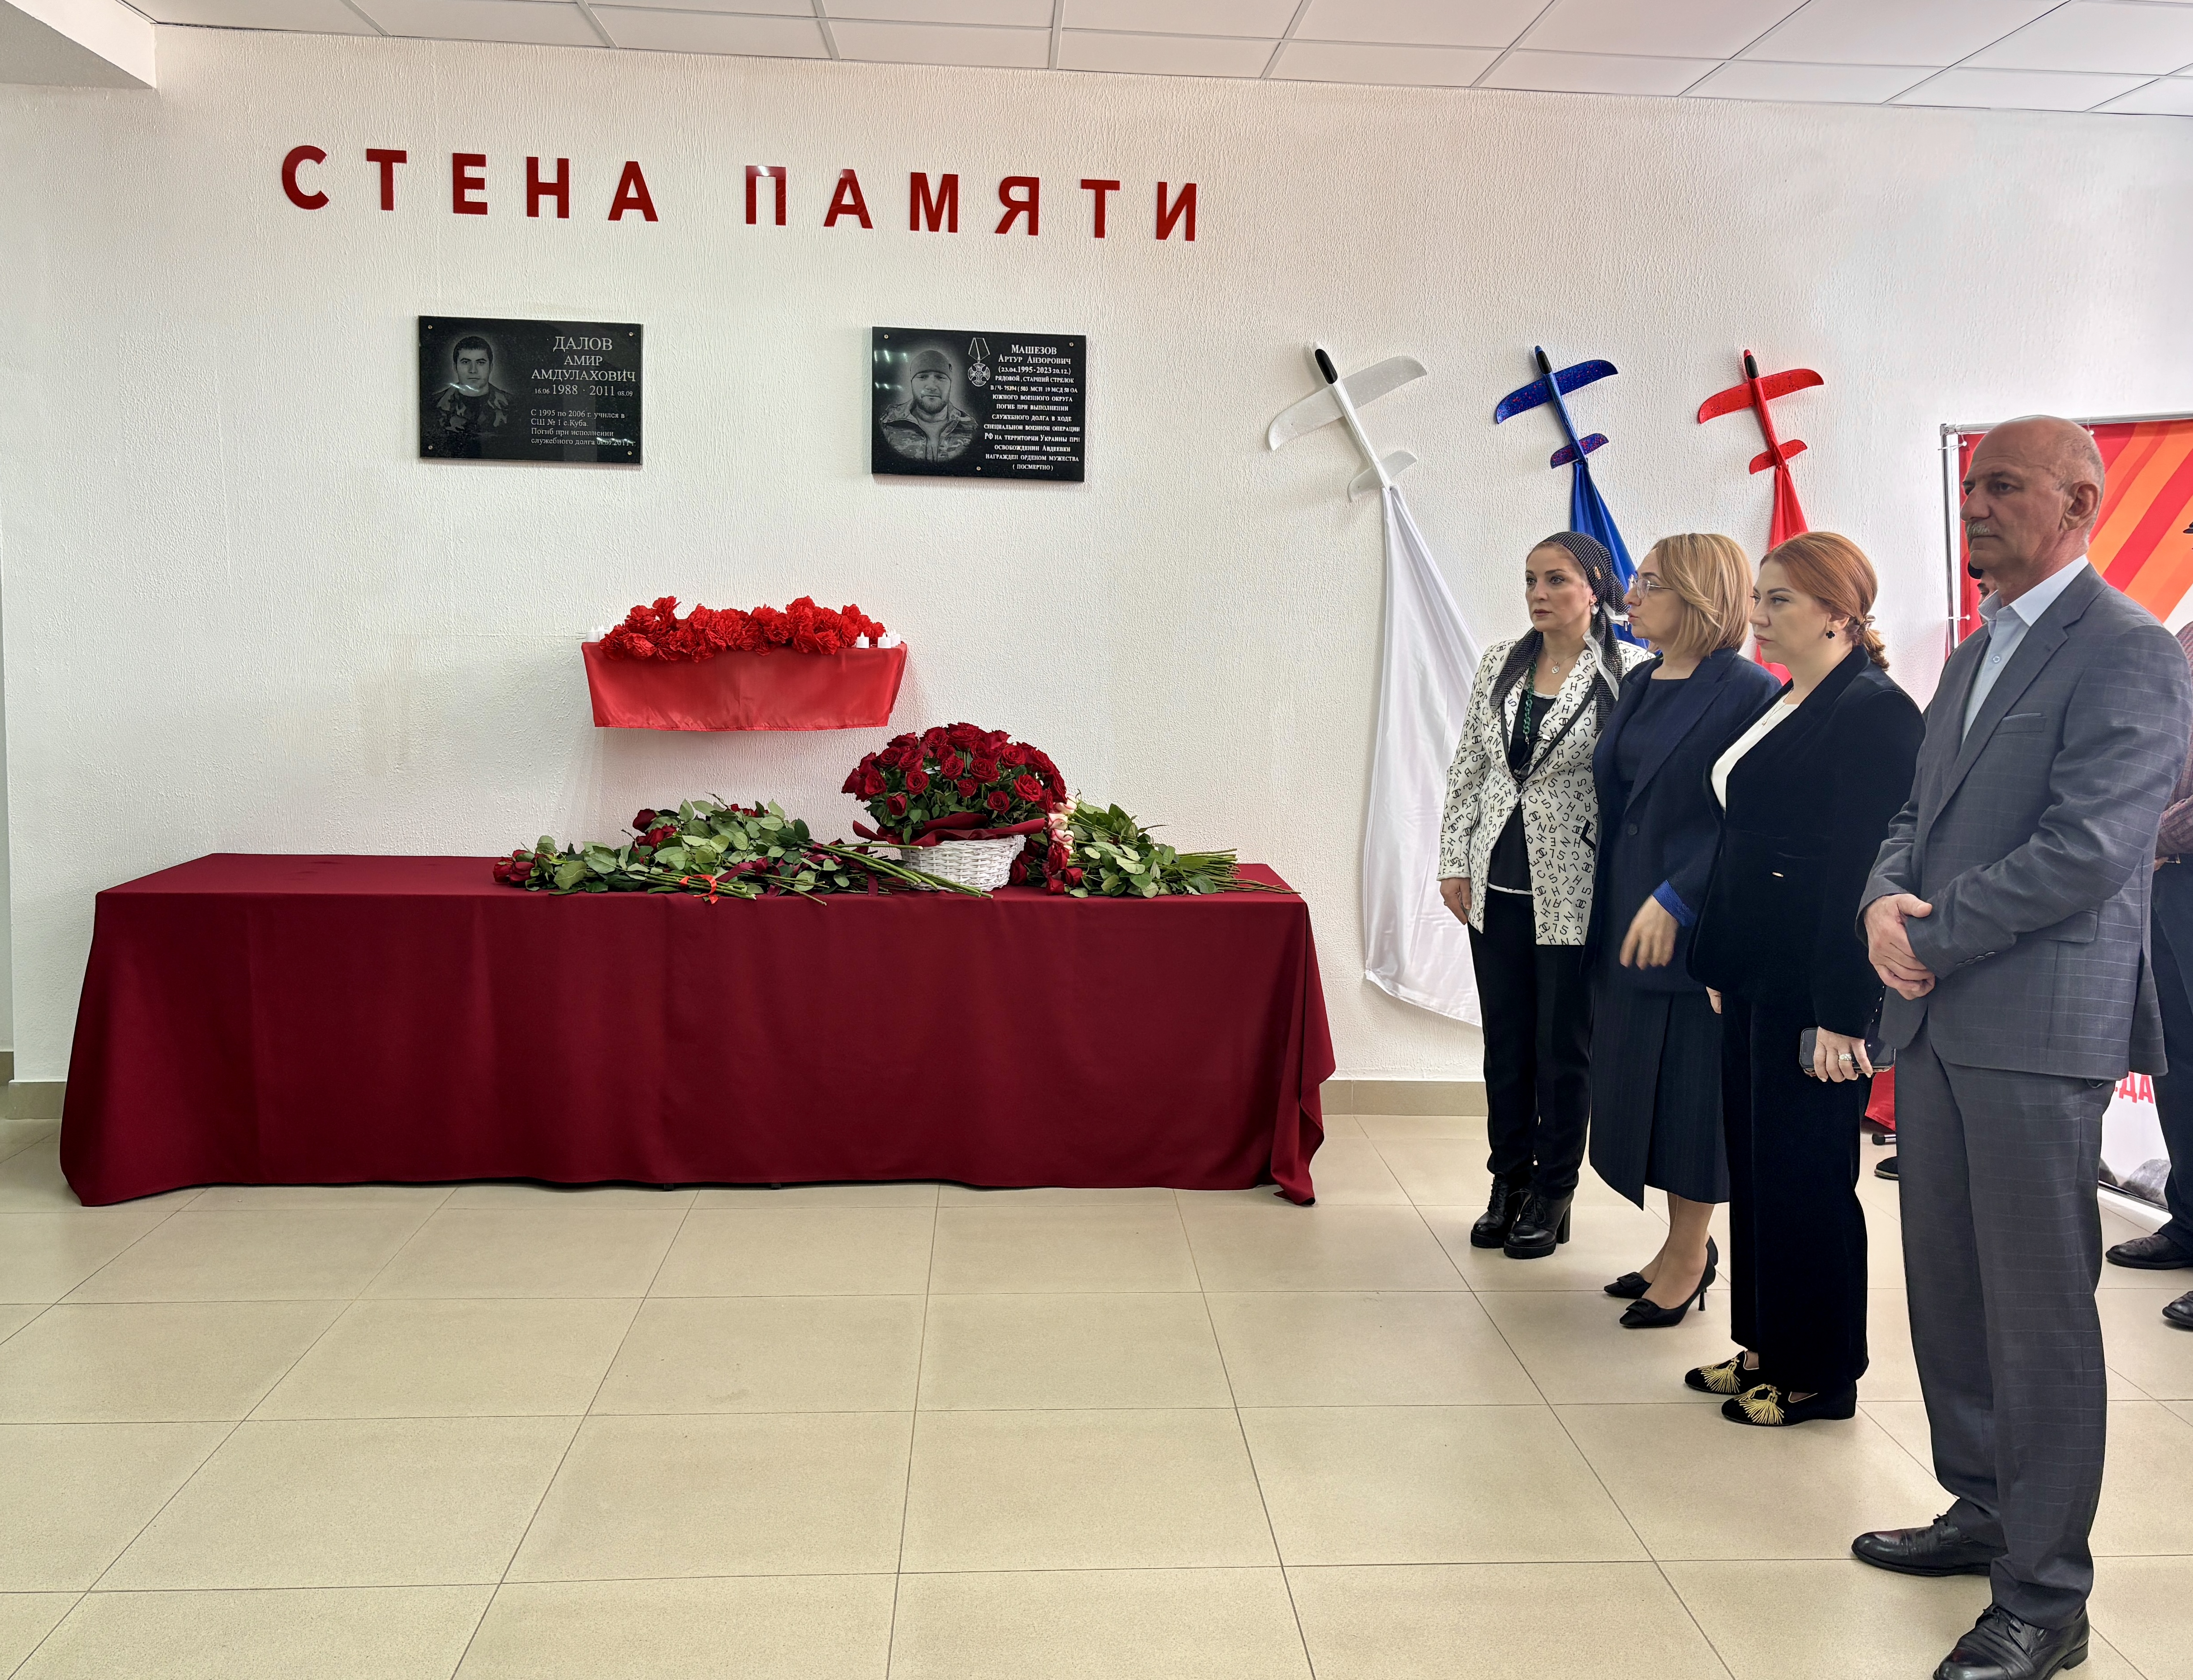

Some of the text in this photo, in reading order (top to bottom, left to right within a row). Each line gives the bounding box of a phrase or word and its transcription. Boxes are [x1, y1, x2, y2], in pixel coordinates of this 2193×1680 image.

[282, 145, 1197, 241] СТЕНА ПАМЯТИ
[553, 337, 612, 352] ДАЛОВ
[564, 355, 603, 366] АМИР
[531, 369, 636, 381] АМДУЛАХОВИЧ
[552, 385, 578, 395] 1988
[590, 385, 615, 396] 2011
